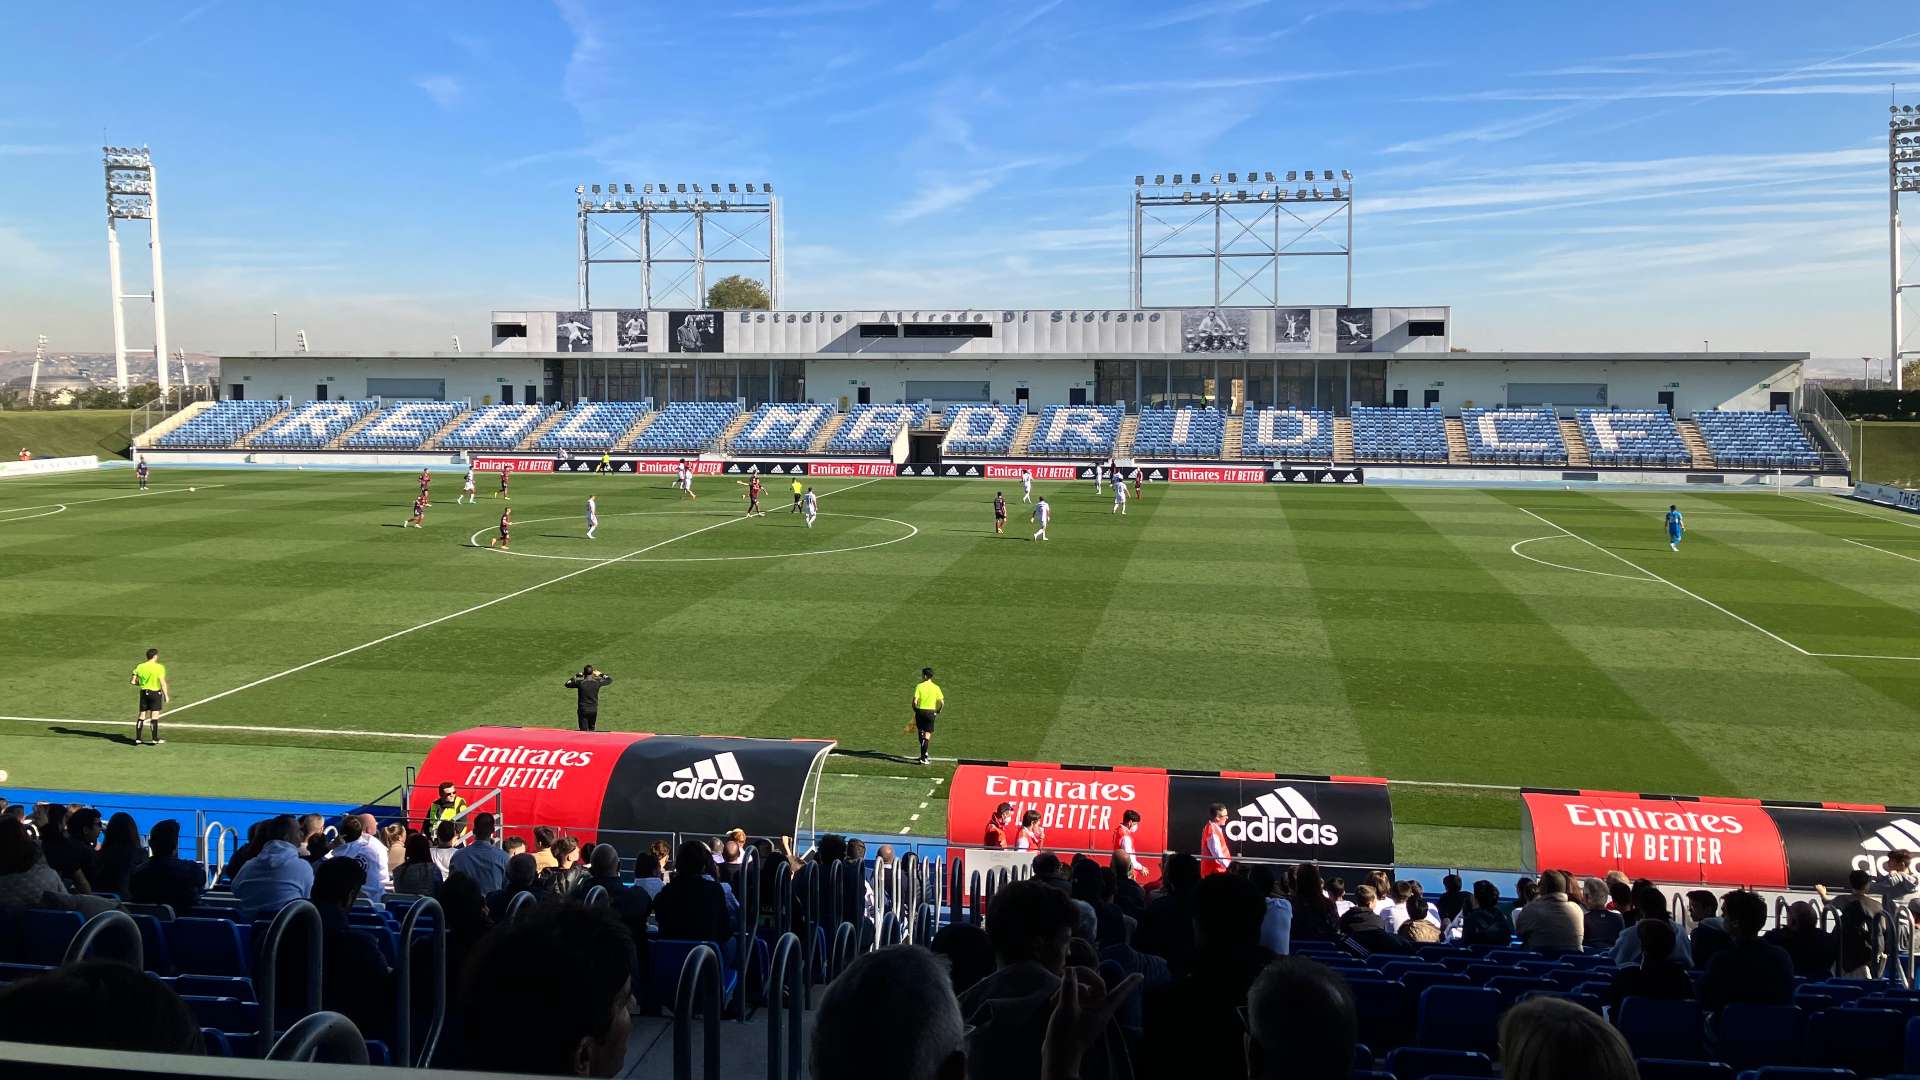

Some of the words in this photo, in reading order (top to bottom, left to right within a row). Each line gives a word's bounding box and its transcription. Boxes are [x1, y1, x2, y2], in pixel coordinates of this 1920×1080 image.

[741, 311, 842, 323] Estadio
[880, 311, 983, 323] Alfredo
[1002, 311, 1029, 323] Di
[272, 404, 610, 439] REAL
[746, 405, 1319, 446] MADRID
[1478, 412, 1651, 452] CF
[473, 460, 515, 470] Emirates
[518, 461, 529, 470] FLY
[529, 461, 552, 471] BETTER
[640, 462, 683, 473] Emirate
[698, 463, 722, 473] BETTER
[811, 463, 854, 474] Emirates
[858, 464, 869, 474] FLY
[870, 464, 894, 475] BETTER
[987, 466, 1032, 477] Emirats
[1036, 467, 1048, 478] FLY
[1049, 467, 1075, 479] BETTER
[1171, 469, 1220, 481] Emirates
[1223, 470, 1236, 481] FLY
[1237, 470, 1265, 482] BETTER
[457, 743, 593, 767] Emirates
[464, 765, 500, 788] FLY
[498, 767, 564, 790] BETTER
[656, 777, 756, 802] adidas
[985, 775, 1136, 802] Emirates
[1042, 803, 1112, 831] BETTER
[1564, 803, 1744, 834] Emirates
[1225, 815, 1339, 846] adidas
[1600, 831, 1635, 859] FLY
[1644, 833, 1723, 865] BETTER
